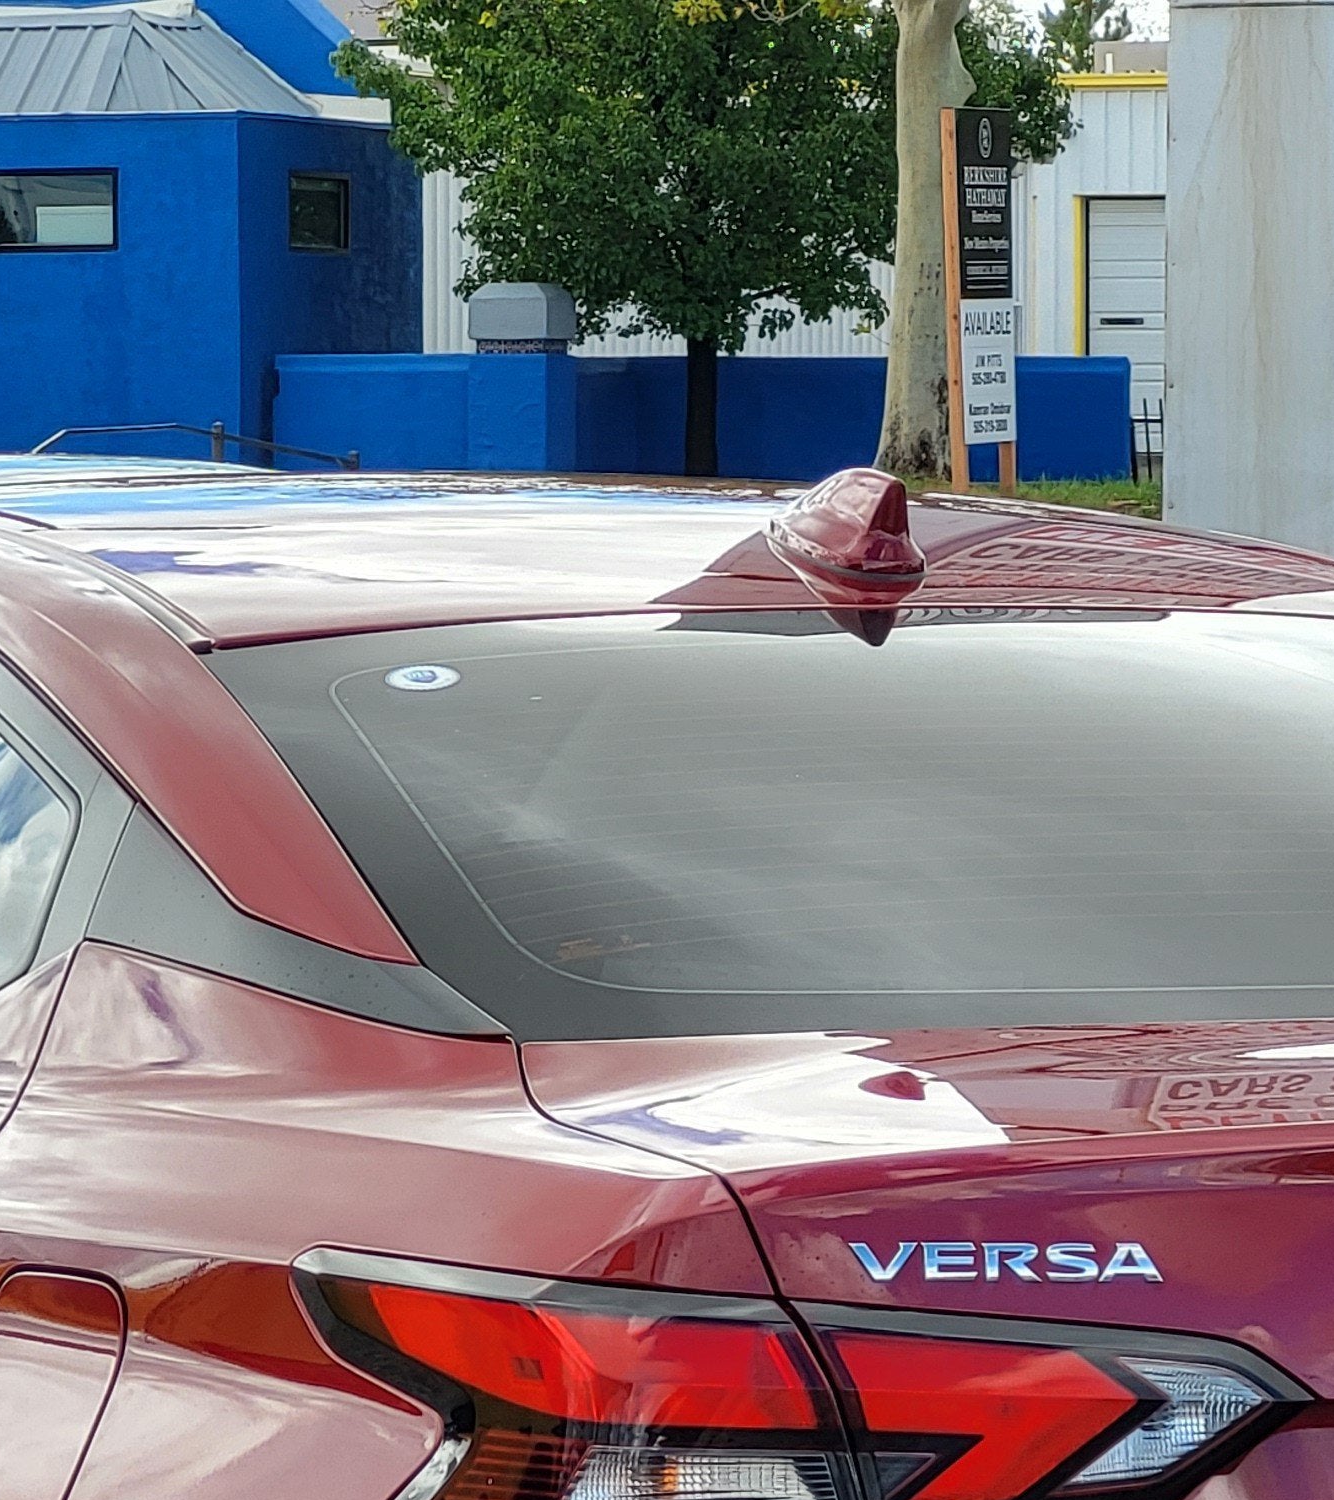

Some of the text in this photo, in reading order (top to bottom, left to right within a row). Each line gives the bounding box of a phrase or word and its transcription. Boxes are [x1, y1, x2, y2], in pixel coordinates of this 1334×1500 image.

[964, 166, 1008, 185] BERKSHIRE
[965, 188, 1007, 207] HATHAWAY
[964, 311, 1012, 336] AVAILABLE
[848, 1242, 1164, 1282] VERSA
